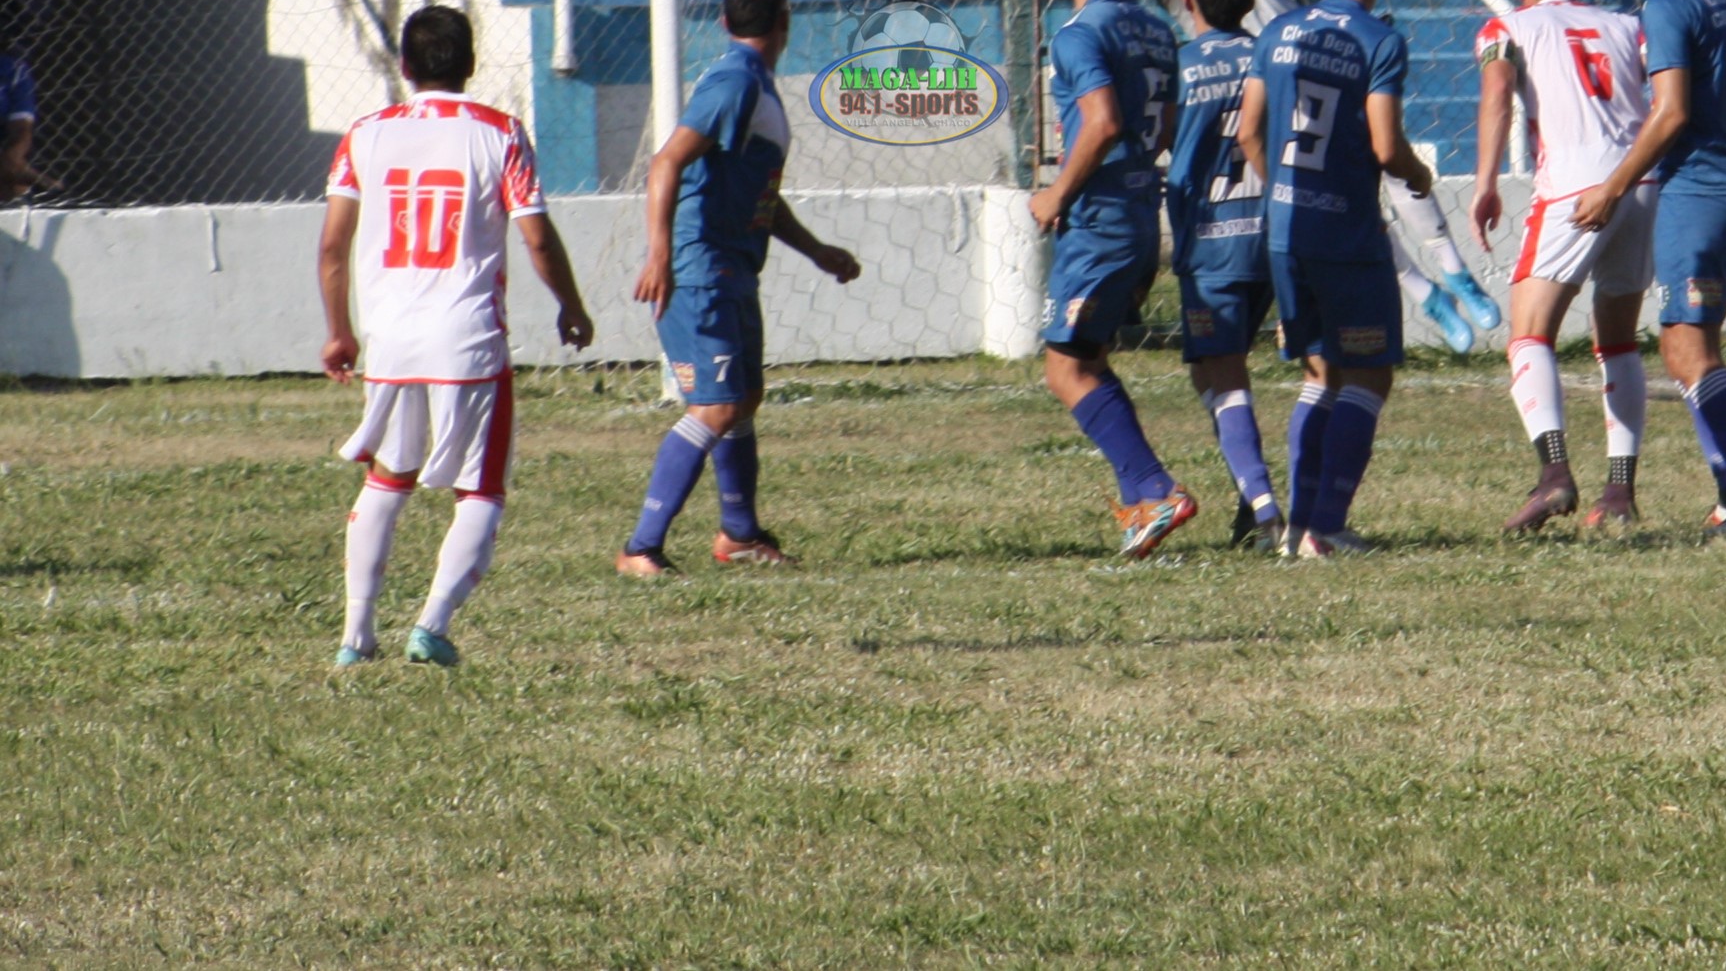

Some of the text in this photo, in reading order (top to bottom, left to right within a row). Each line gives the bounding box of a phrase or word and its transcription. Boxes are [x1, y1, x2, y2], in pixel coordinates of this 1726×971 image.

[1281, 25, 1319, 45] Club
[1182, 60, 1232, 84] Club
[1272, 46, 1361, 79] COMERCIO
[1564, 27, 1613, 102] 6
[1281, 78, 1342, 171] 9
[383, 168, 465, 269] 10
[713, 355, 732, 383] 7
